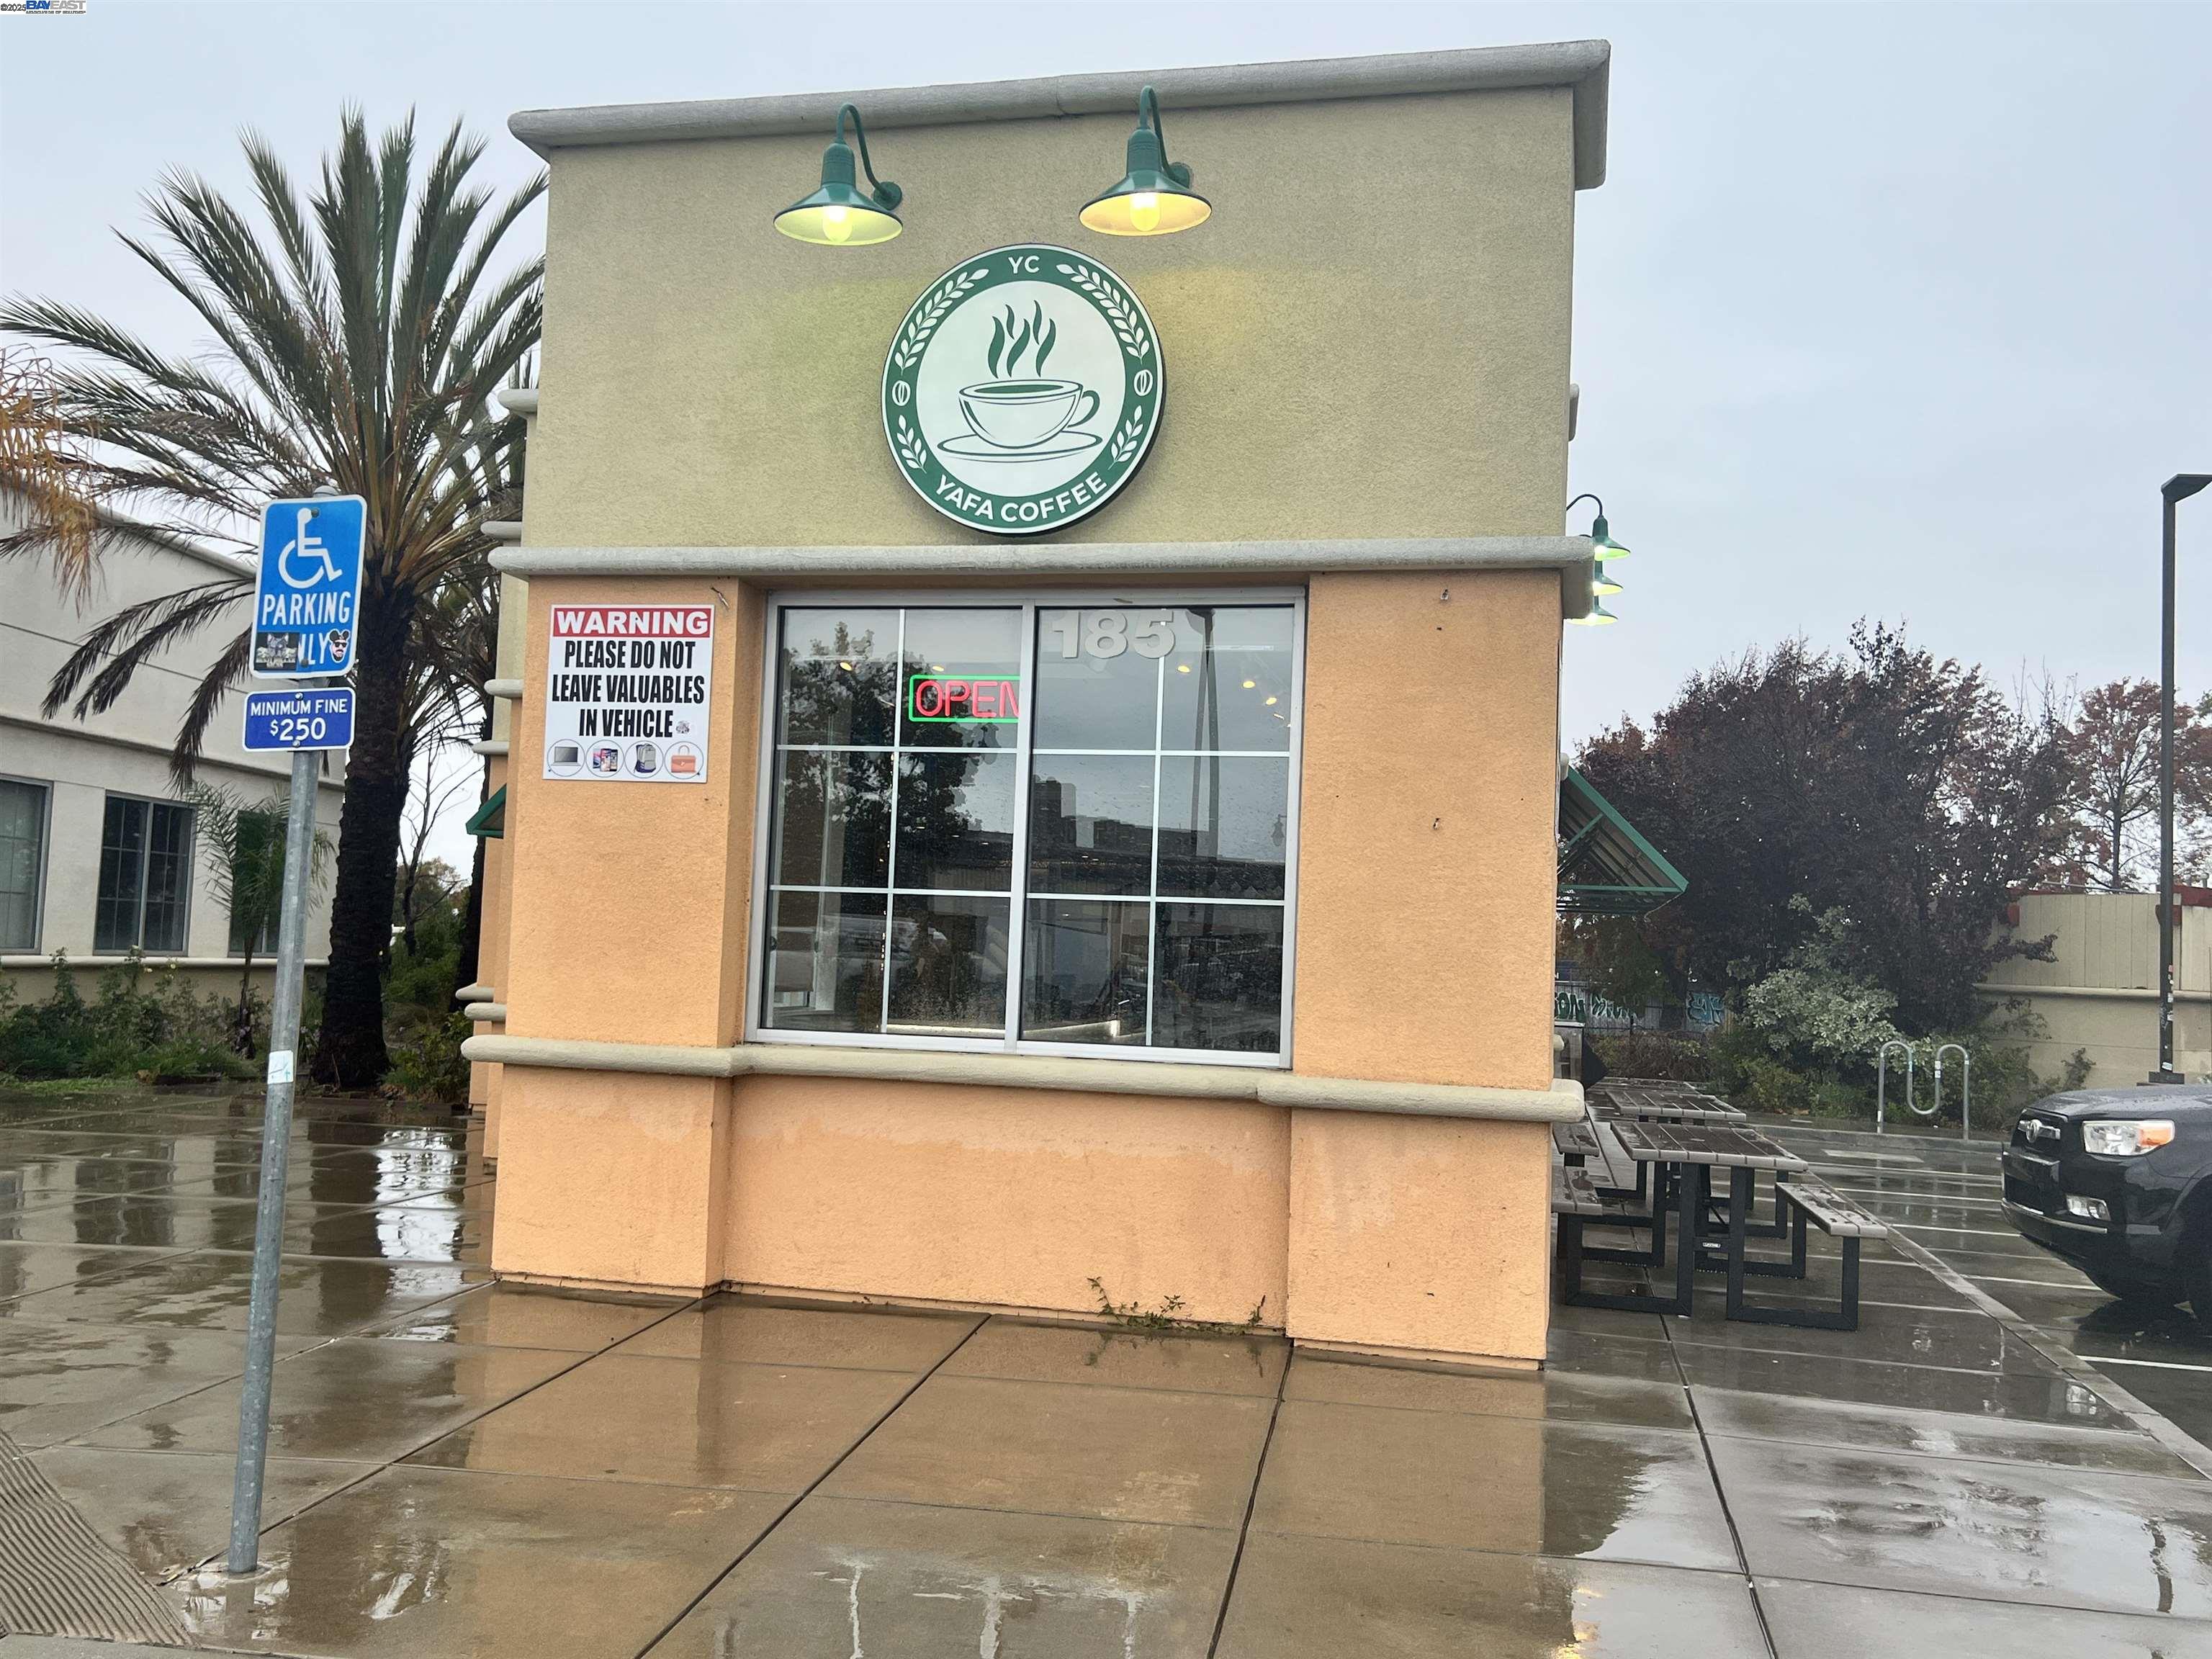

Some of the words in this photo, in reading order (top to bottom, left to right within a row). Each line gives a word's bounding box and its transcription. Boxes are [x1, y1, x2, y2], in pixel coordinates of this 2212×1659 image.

[1008, 255, 1040, 274] YC
[935, 474, 994, 520] YAFA
[1000, 472, 1107, 523] COFFEE
[261, 590, 351, 626] PARKING
[556, 611, 709, 635] WARNING
[1049, 609, 1176, 660] 185
[297, 632, 332, 665] NLY
[564, 640, 627, 669] PLEASE
[630, 640, 655, 669] DO
[660, 641, 696, 669] NOT
[552, 674, 603, 702] LEAVE
[606, 675, 705, 704] VALUABLES
[916, 680, 1020, 717] OPEN
[251, 699, 311, 716] MINIMUM
[315, 698, 348, 714] FINE
[270, 717, 327, 742] $250
[579, 709, 598, 737] IN
[602, 709, 674, 738] VEHICLE
